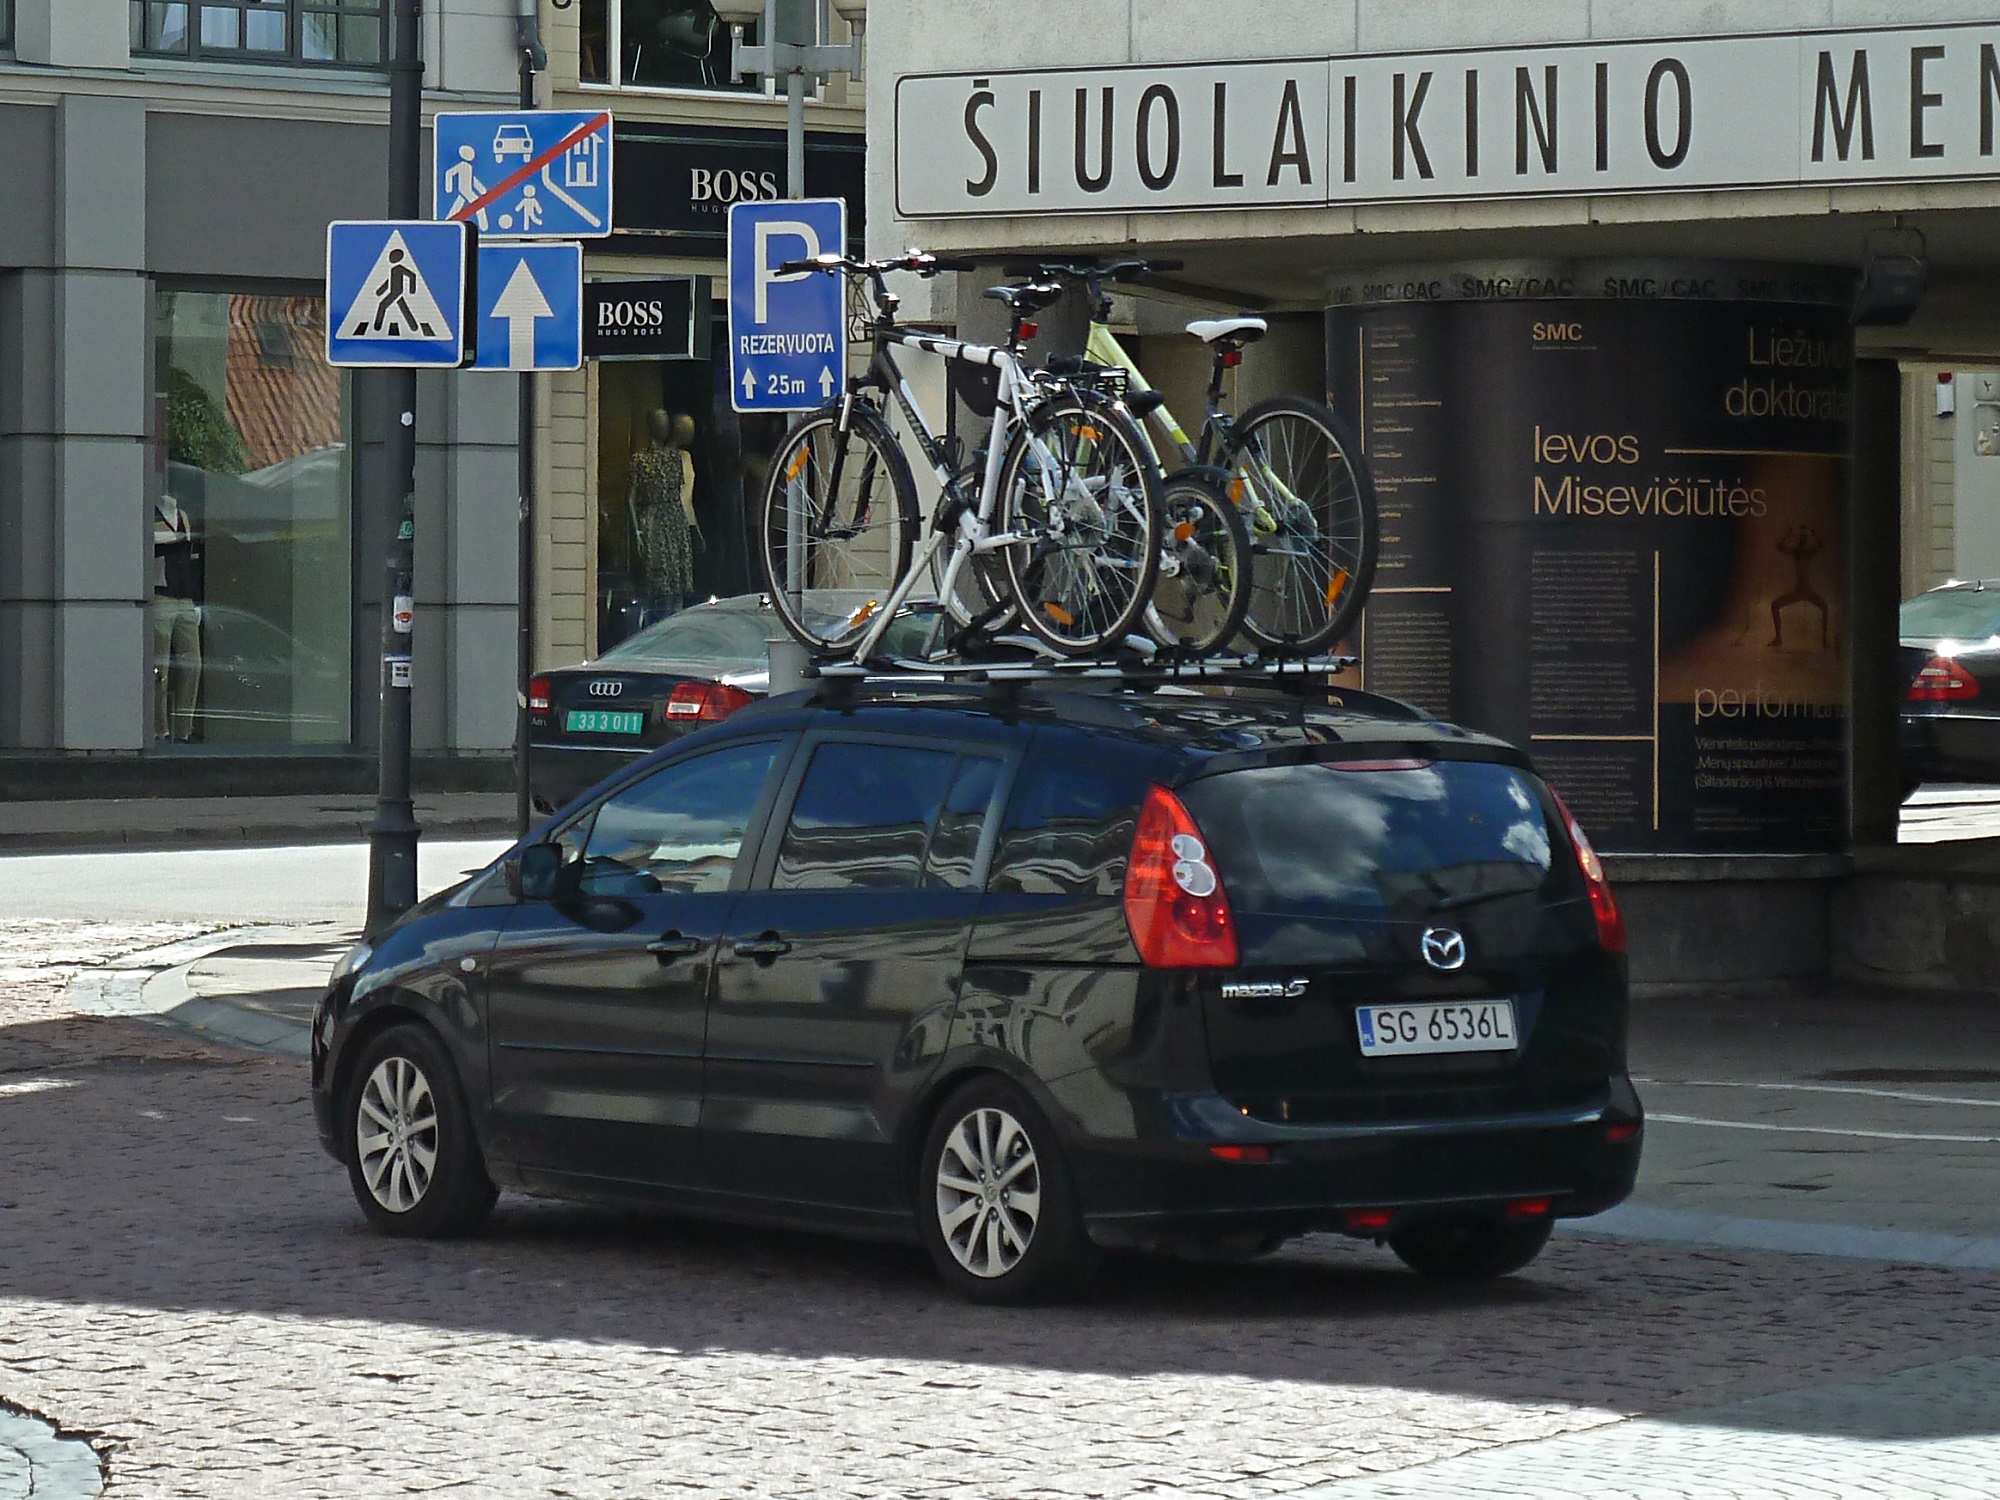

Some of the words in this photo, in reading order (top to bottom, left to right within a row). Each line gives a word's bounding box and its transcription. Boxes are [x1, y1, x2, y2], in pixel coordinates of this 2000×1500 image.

[964, 58, 1693, 197] ŠIUOLAIKINIO
[690, 168, 778, 202] BOSS
[754, 220, 820, 324] P
[597, 300, 663, 327] BOSS
[597, 328, 626, 336] HUGO
[633, 327, 662, 336] BOSS
[740, 333, 834, 356] REZERVUOTA
[1532, 321, 1583, 341] SMC
[767, 374, 806, 395] 25m
[1533, 425, 1640, 464] Ievos
[1533, 475, 1768, 517] Misevičiūtės
[1377, 1010, 1418, 1044] SG
[1428, 1005, 1509, 1042] 6536L
